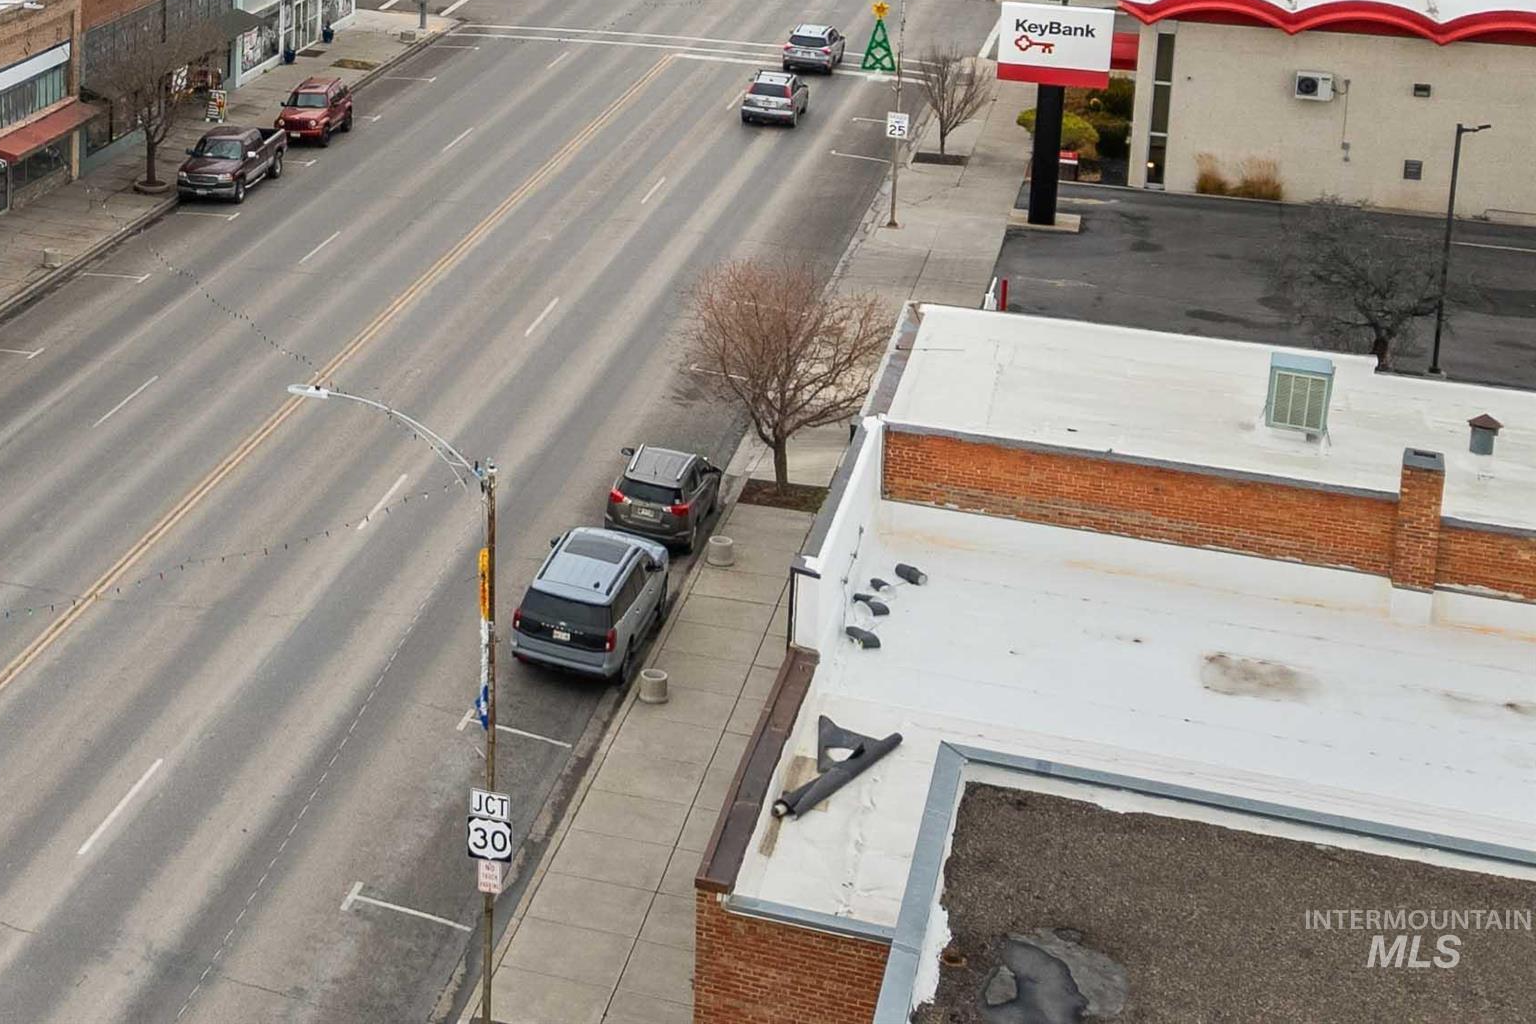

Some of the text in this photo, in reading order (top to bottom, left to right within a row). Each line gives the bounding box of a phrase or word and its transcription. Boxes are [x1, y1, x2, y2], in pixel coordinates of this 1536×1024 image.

[1015, 18, 1096, 38] KeyBank
[889, 124, 905, 136] 25
[473, 794, 508, 817] JCT
[473, 827, 507, 852] 30
[485, 863, 495, 872] NO
